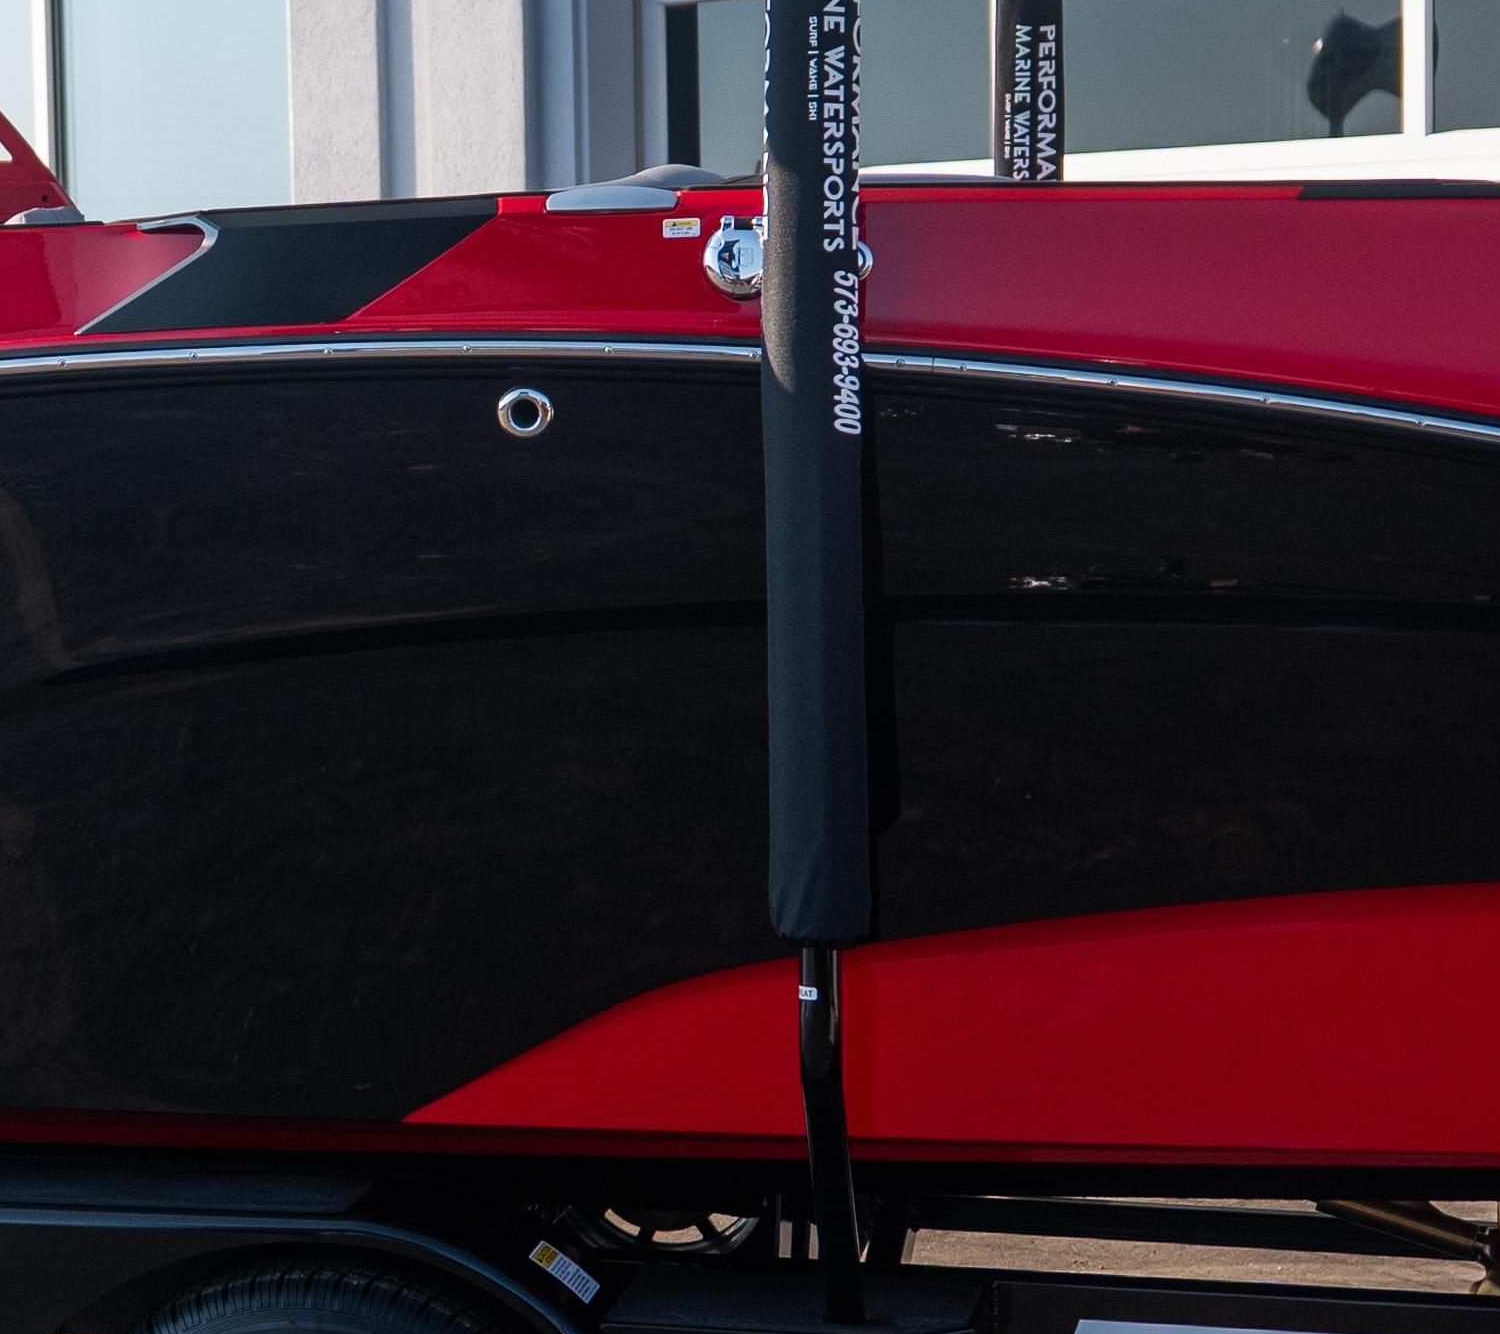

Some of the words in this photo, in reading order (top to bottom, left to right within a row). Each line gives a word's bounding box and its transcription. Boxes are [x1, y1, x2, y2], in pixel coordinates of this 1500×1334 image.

[1014, 24, 1033, 104] MARINE
[1037, 24, 1057, 182] PERFORMA
[822, 45, 846, 254] WATERSPORTS
[832, 269, 862, 435] 573-693-9400
